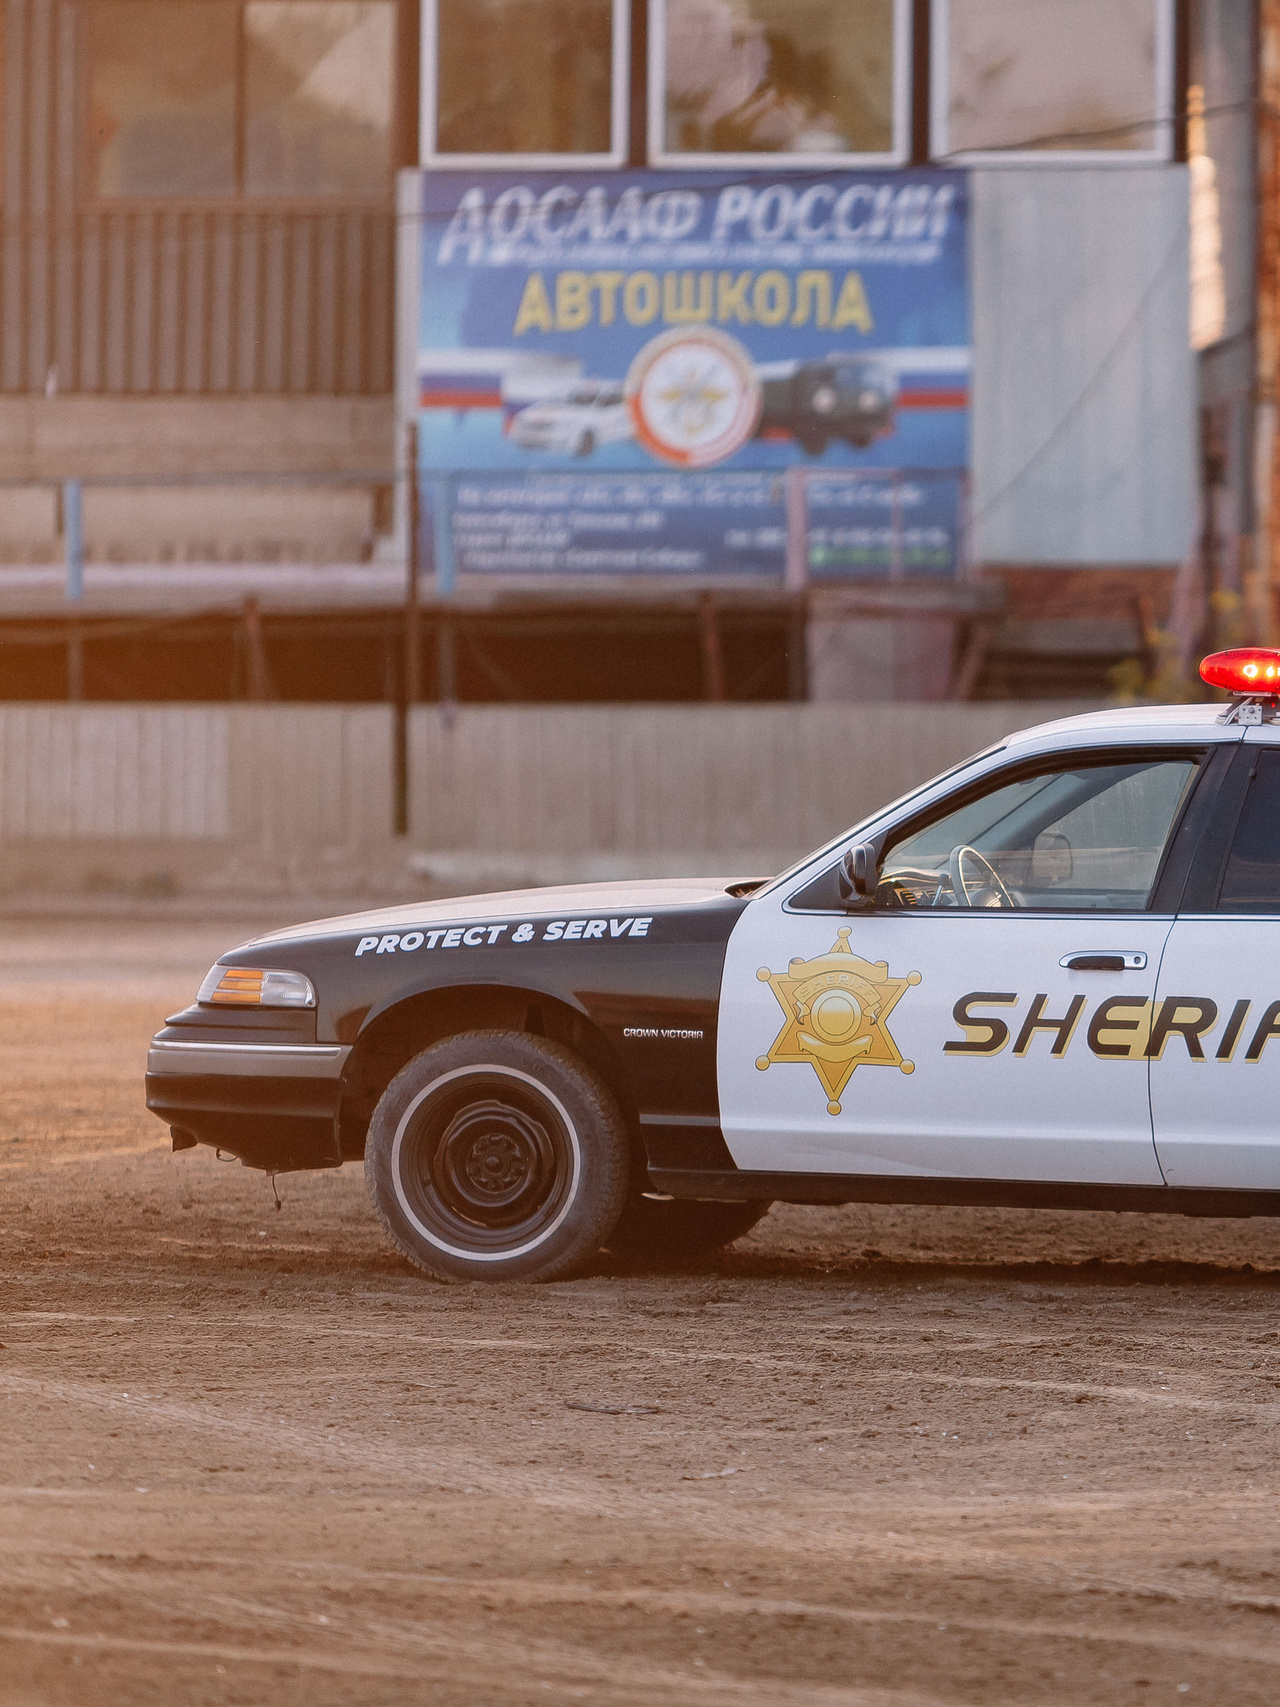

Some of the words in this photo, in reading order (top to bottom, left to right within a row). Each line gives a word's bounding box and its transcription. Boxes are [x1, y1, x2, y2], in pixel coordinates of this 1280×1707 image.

[436, 184, 702, 267] ДОСААФ
[709, 183, 955, 242] РОССИИ
[512, 269, 875, 338] АВТОШКОЛА
[354, 924, 508, 957] PROTECT
[511, 923, 536, 943] &
[542, 916, 654, 941] SERVE
[799, 973, 877, 998] SHERIFF
[623, 1027, 659, 1038] CROWN
[660, 1028, 704, 1040] VICTORIA
